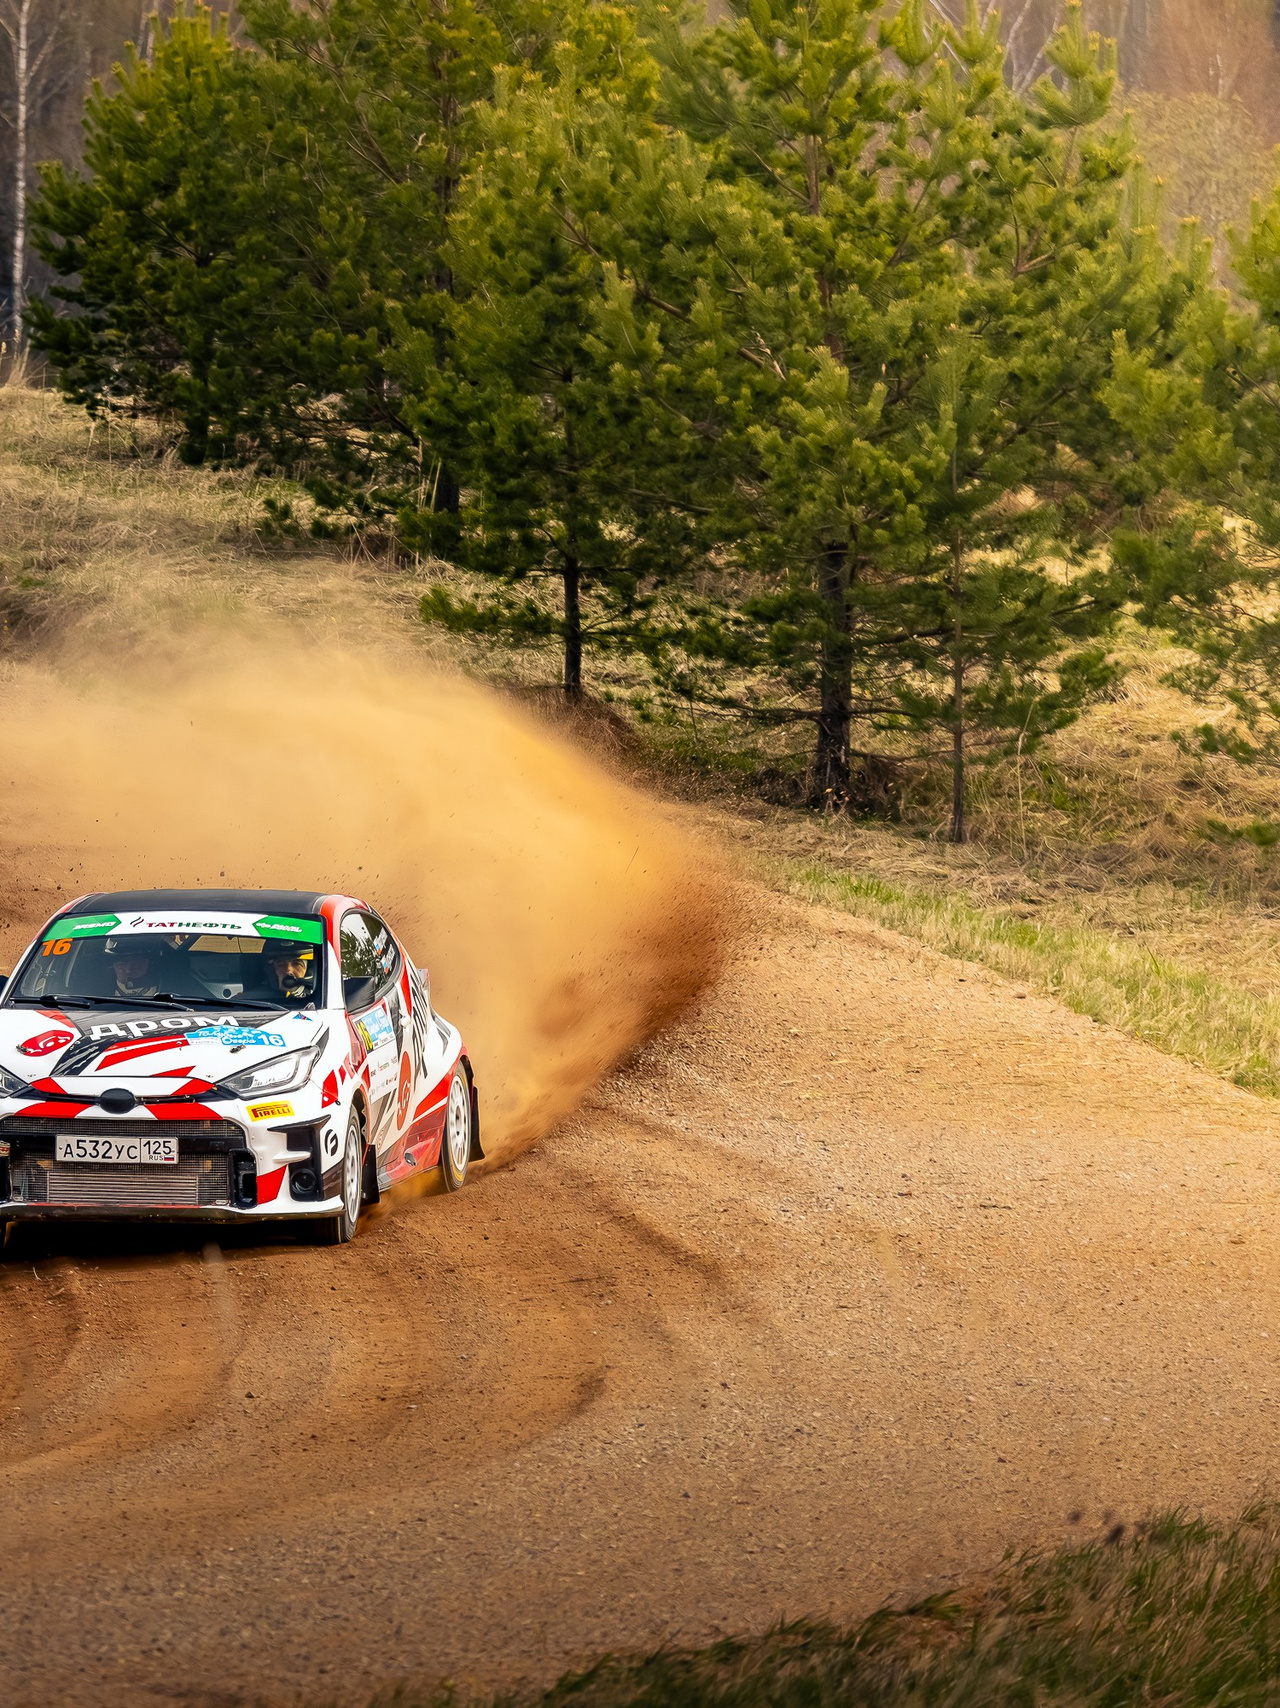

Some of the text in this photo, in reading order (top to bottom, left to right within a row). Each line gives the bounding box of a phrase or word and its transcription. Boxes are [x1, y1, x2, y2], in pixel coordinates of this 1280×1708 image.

[146, 921, 242, 930] ТАТНЕФТЬ
[41, 938, 73, 956] 16
[258, 1034, 284, 1046] 16
[251, 1104, 291, 1118] PIRELLI
[143, 1141, 172, 1155] 125
